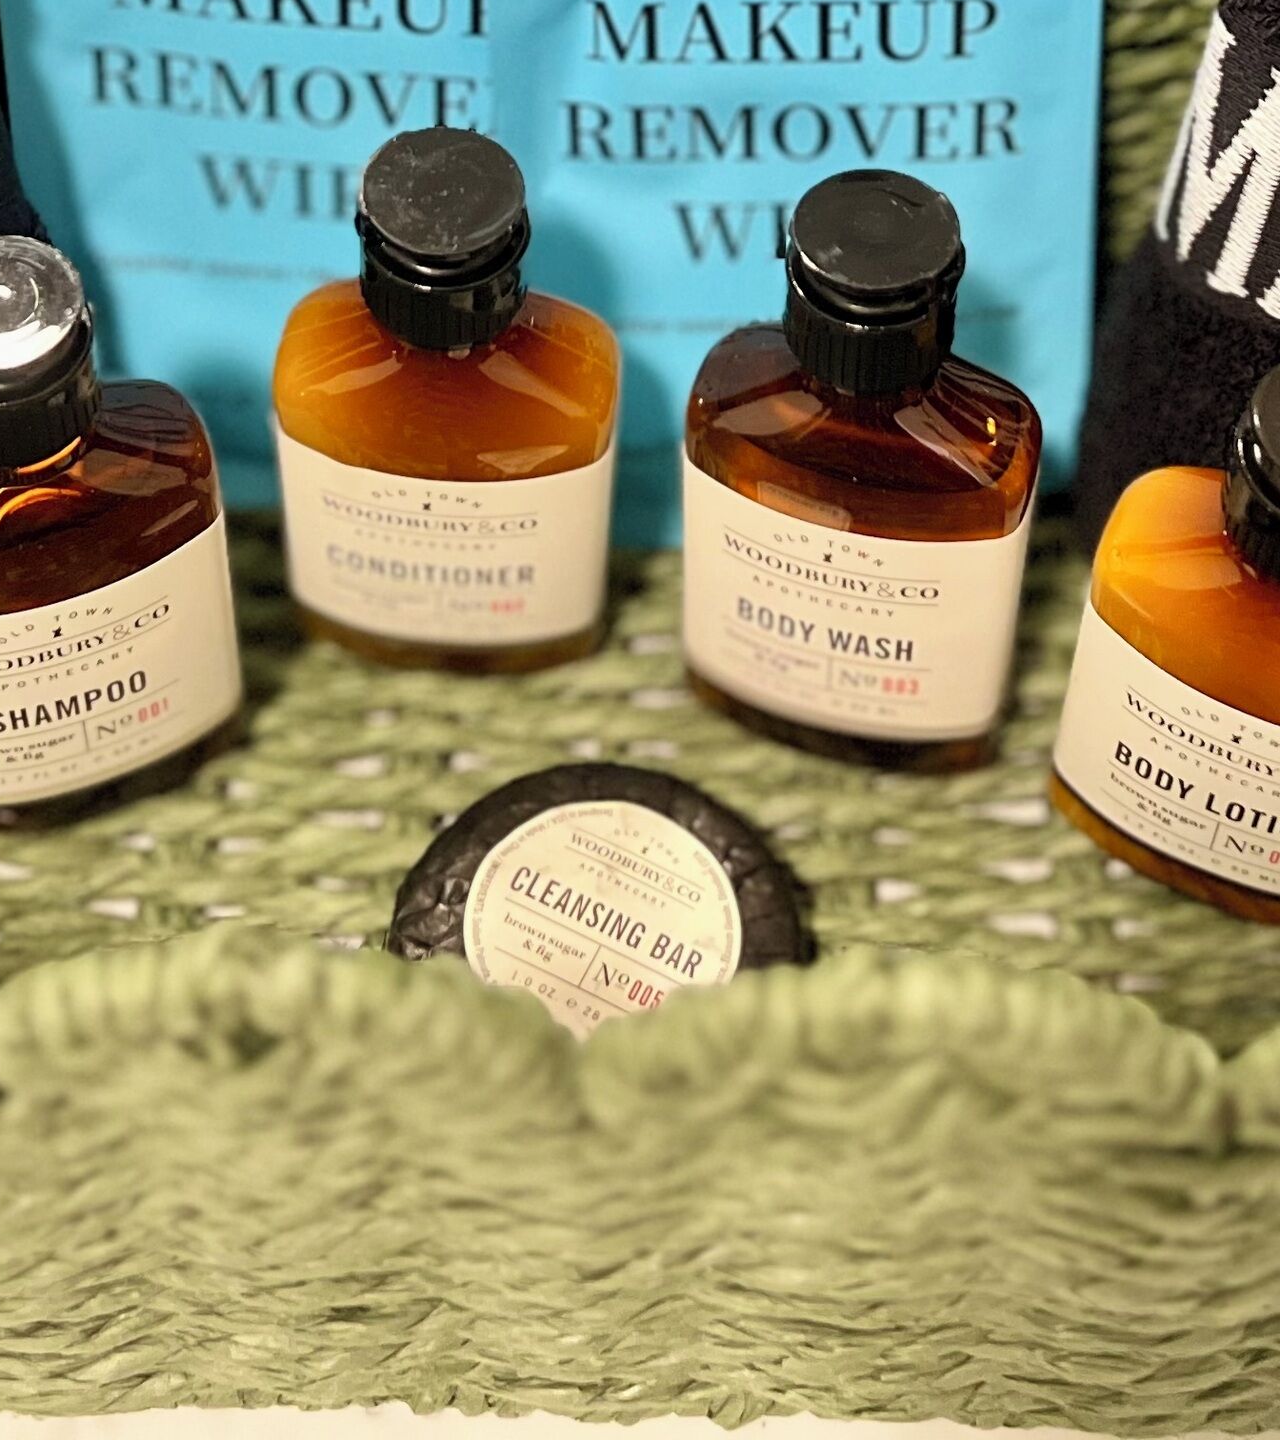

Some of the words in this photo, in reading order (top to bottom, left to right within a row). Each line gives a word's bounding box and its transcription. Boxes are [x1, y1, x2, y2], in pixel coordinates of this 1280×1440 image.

[87, 43, 488, 131] REMOVE
[562, 97, 1024, 167] REMOVER
[326, 543, 535, 587] CONDITIONER
[724, 533, 940, 599] WOODBURY&CO
[736, 596, 817, 645] BODY
[827, 627, 915, 663] WASH
[1113, 739, 1195, 800] BODY
[570, 832, 702, 904] WOODBURY&CO
[503, 911, 547, 942] brown
[547, 933, 588, 960] sugar
[509, 866, 647, 950] CLEANSING
[648, 932, 704, 980] BAR
[522, 938, 534, 952] &
[535, 944, 554, 963] fig
[627, 978, 665, 1010] 005
